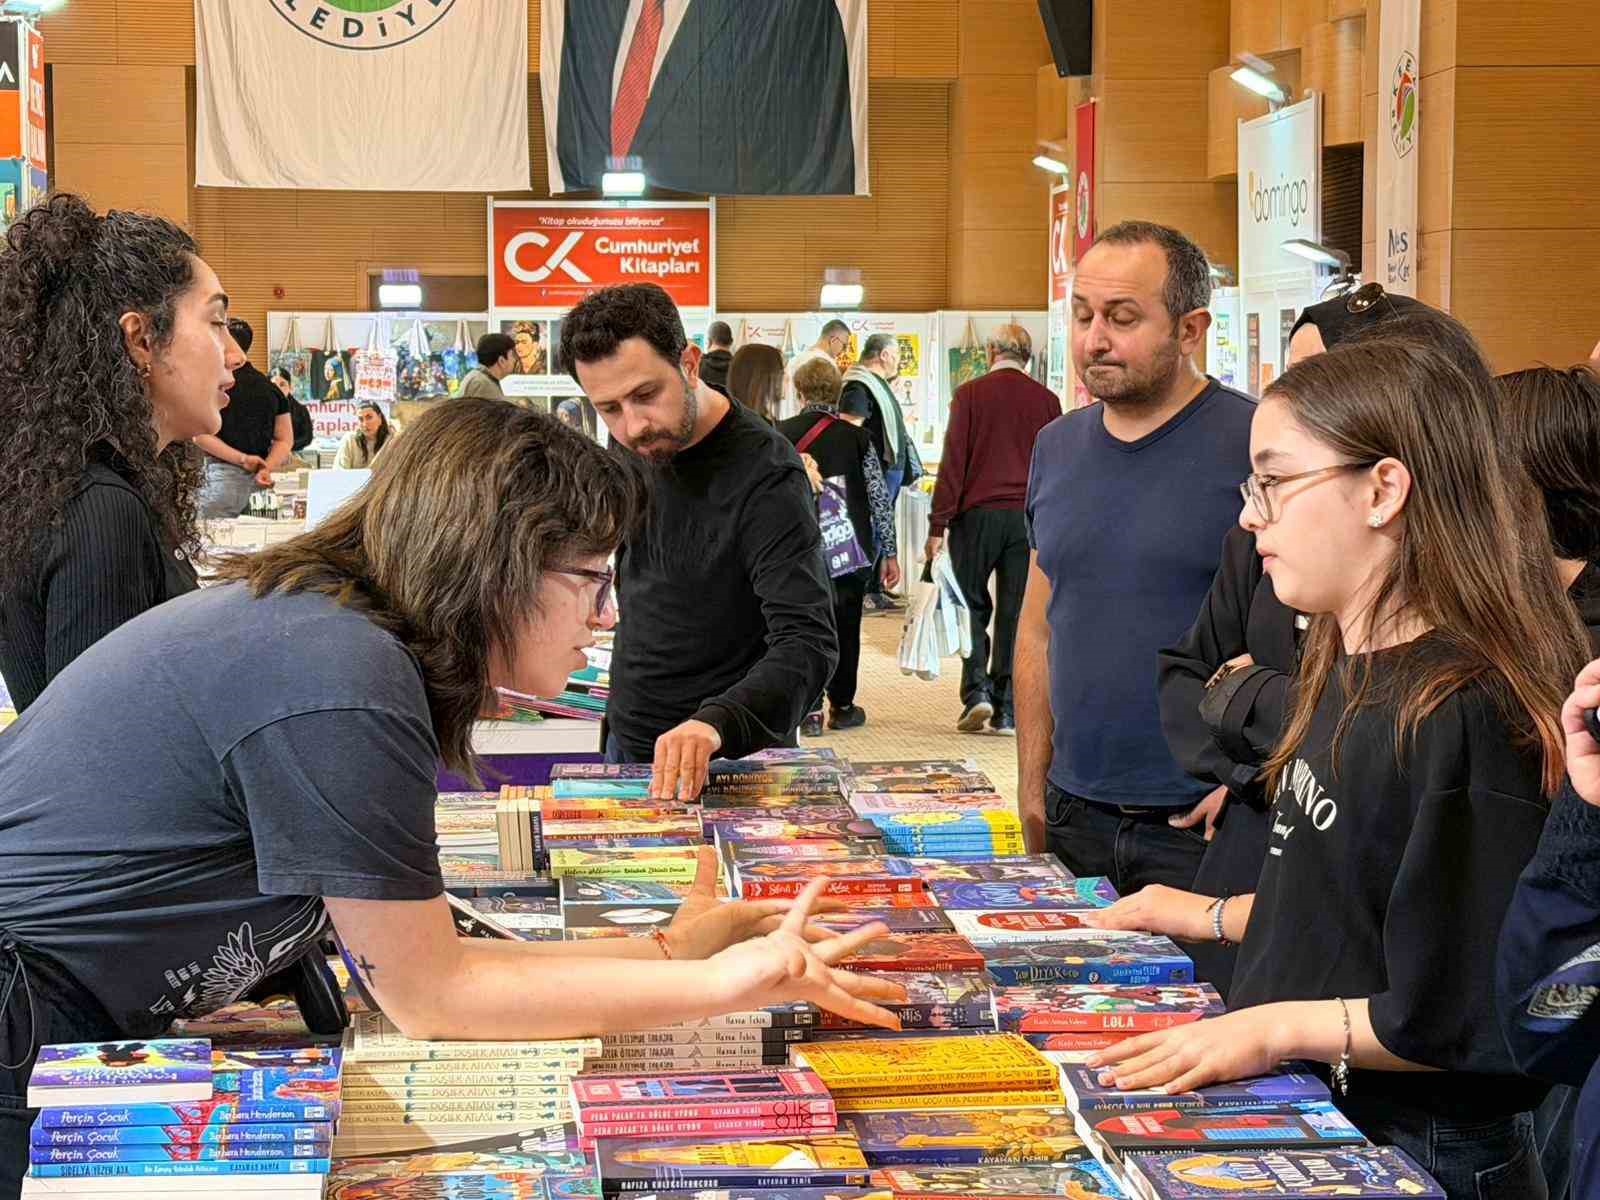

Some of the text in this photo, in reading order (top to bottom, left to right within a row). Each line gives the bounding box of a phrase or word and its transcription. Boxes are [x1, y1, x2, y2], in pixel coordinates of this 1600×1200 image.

[1253, 172, 1308, 228] domingo
[594, 236, 700, 258] Cumhuriyet
[619, 257, 700, 279] Kitapları
[1102, 1015, 1136, 1029] LOLA
[61, 1106, 296, 1126] Perçin Çocuk Barbara Henderson
[590, 1111, 609, 1122] PERA
[51, 1130, 85, 1144] Perçin
[87, 1129, 121, 1145] Çocuk
[240, 1128, 286, 1141] Henderson
[593, 1126, 612, 1135] PERA
[50, 1147, 84, 1161] Perçin
[86, 1146, 120, 1162] Çocuk
[240, 1144, 285, 1157] Henderson
[977, 1155, 1021, 1166] KAYAHAN
[620, 1180, 650, 1191] HAFIZA
[757, 1177, 789, 1187] KAYAHAN
